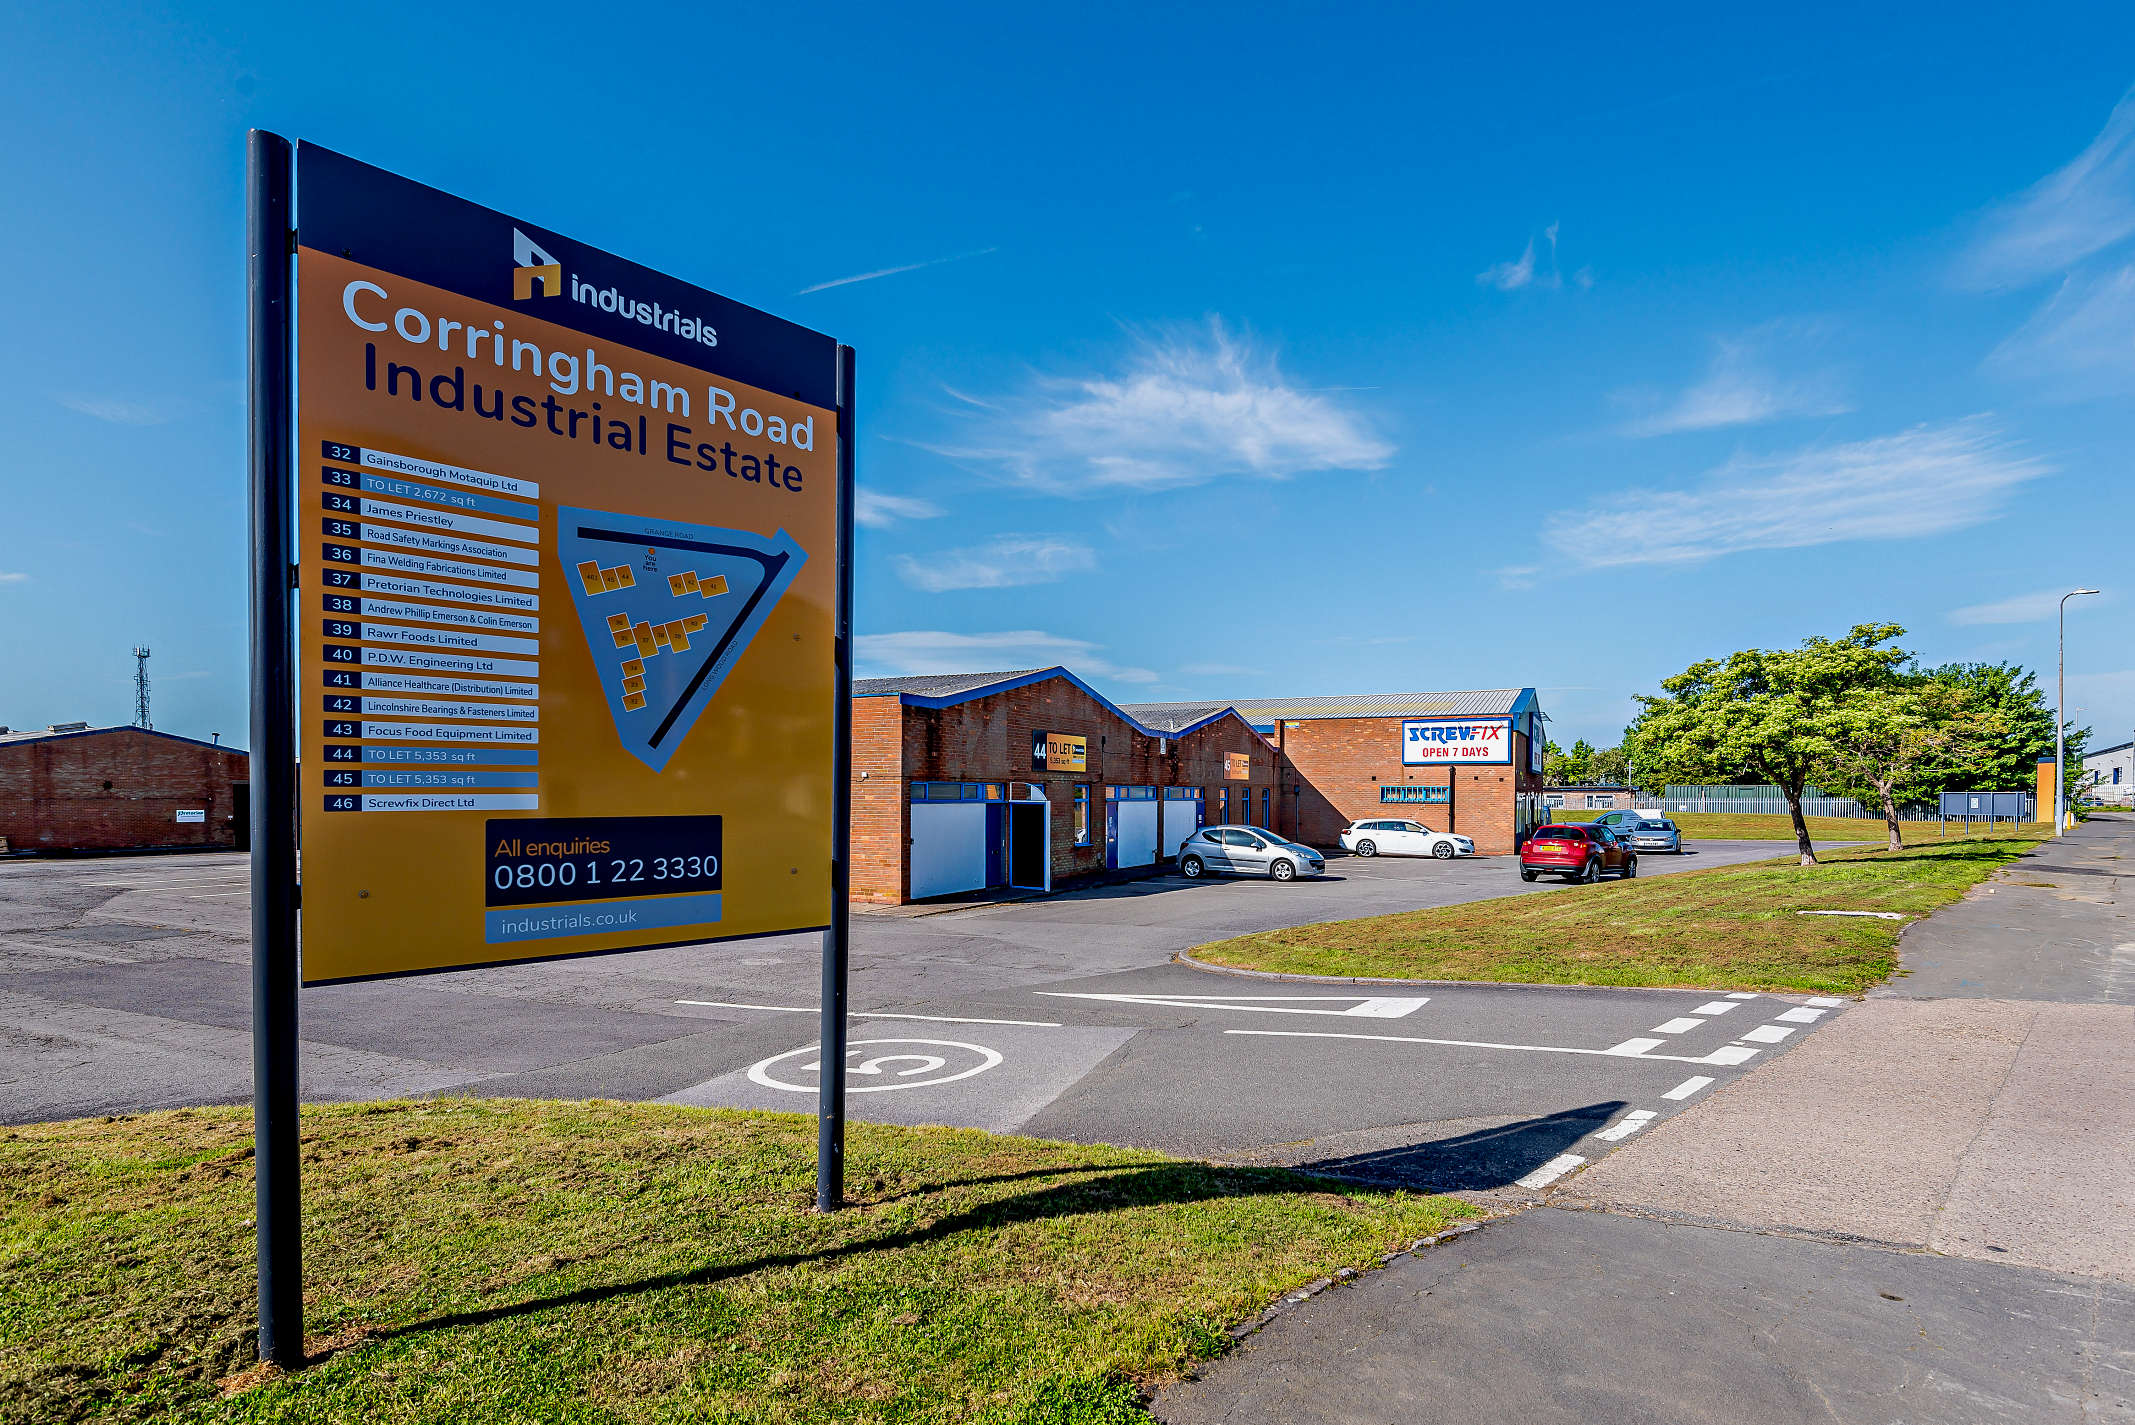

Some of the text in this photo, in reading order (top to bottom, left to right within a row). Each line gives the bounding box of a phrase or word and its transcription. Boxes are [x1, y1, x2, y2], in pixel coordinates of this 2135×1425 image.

[572, 273, 718, 347] industrials
[342, 280, 814, 452] Corringham Road
[365, 342, 804, 492] Industrial Estate
[332, 446, 518, 492] 32 Gainsborough Motaquip Ltd
[332, 472, 476, 507] 33 TO LET 2,672 sq ft
[332, 497, 453, 528] 34 James Priestley
[332, 523, 508, 559] 35 Road Safety Markings Association
[332, 548, 506, 580] 36 Fina Welding Fabrications Limited
[644, 554, 657, 562] You
[332, 573, 532, 607] 37 Pretorian Technologies Limited
[332, 599, 532, 629] 38 Andrew Phillip Emerson & Colin Emerson
[332, 624, 478, 646] 39 Rawr Foods Limited
[333, 649, 493, 671] 40 P.D.W. Engineering Ltd
[333, 674, 533, 696] 41 Alliance Healthcare (Distribution) Limited
[333, 700, 535, 718] 42 Lincolnshire Bearings & Fasteners Limited
[333, 724, 532, 741] 43 Focus Food Equipment Limited
[1409, 724, 1504, 744] SCREWFIX
[333, 749, 476, 763] 44 TO LET 5,353 sq ft
[1034, 742, 1047, 759] 44
[1049, 741, 1071, 755] TO LET
[1423, 747, 1489, 758] OPEN 7 DAYS
[333, 774, 476, 787] 45 TO LET 5,353 sq ft
[333, 798, 475, 809] 46 Screwfix Direct Ltd
[495, 837, 610, 859] All enquiries
[495, 856, 718, 890] 0800 1 22 3330
[502, 909, 637, 934] industrials.co.uk
